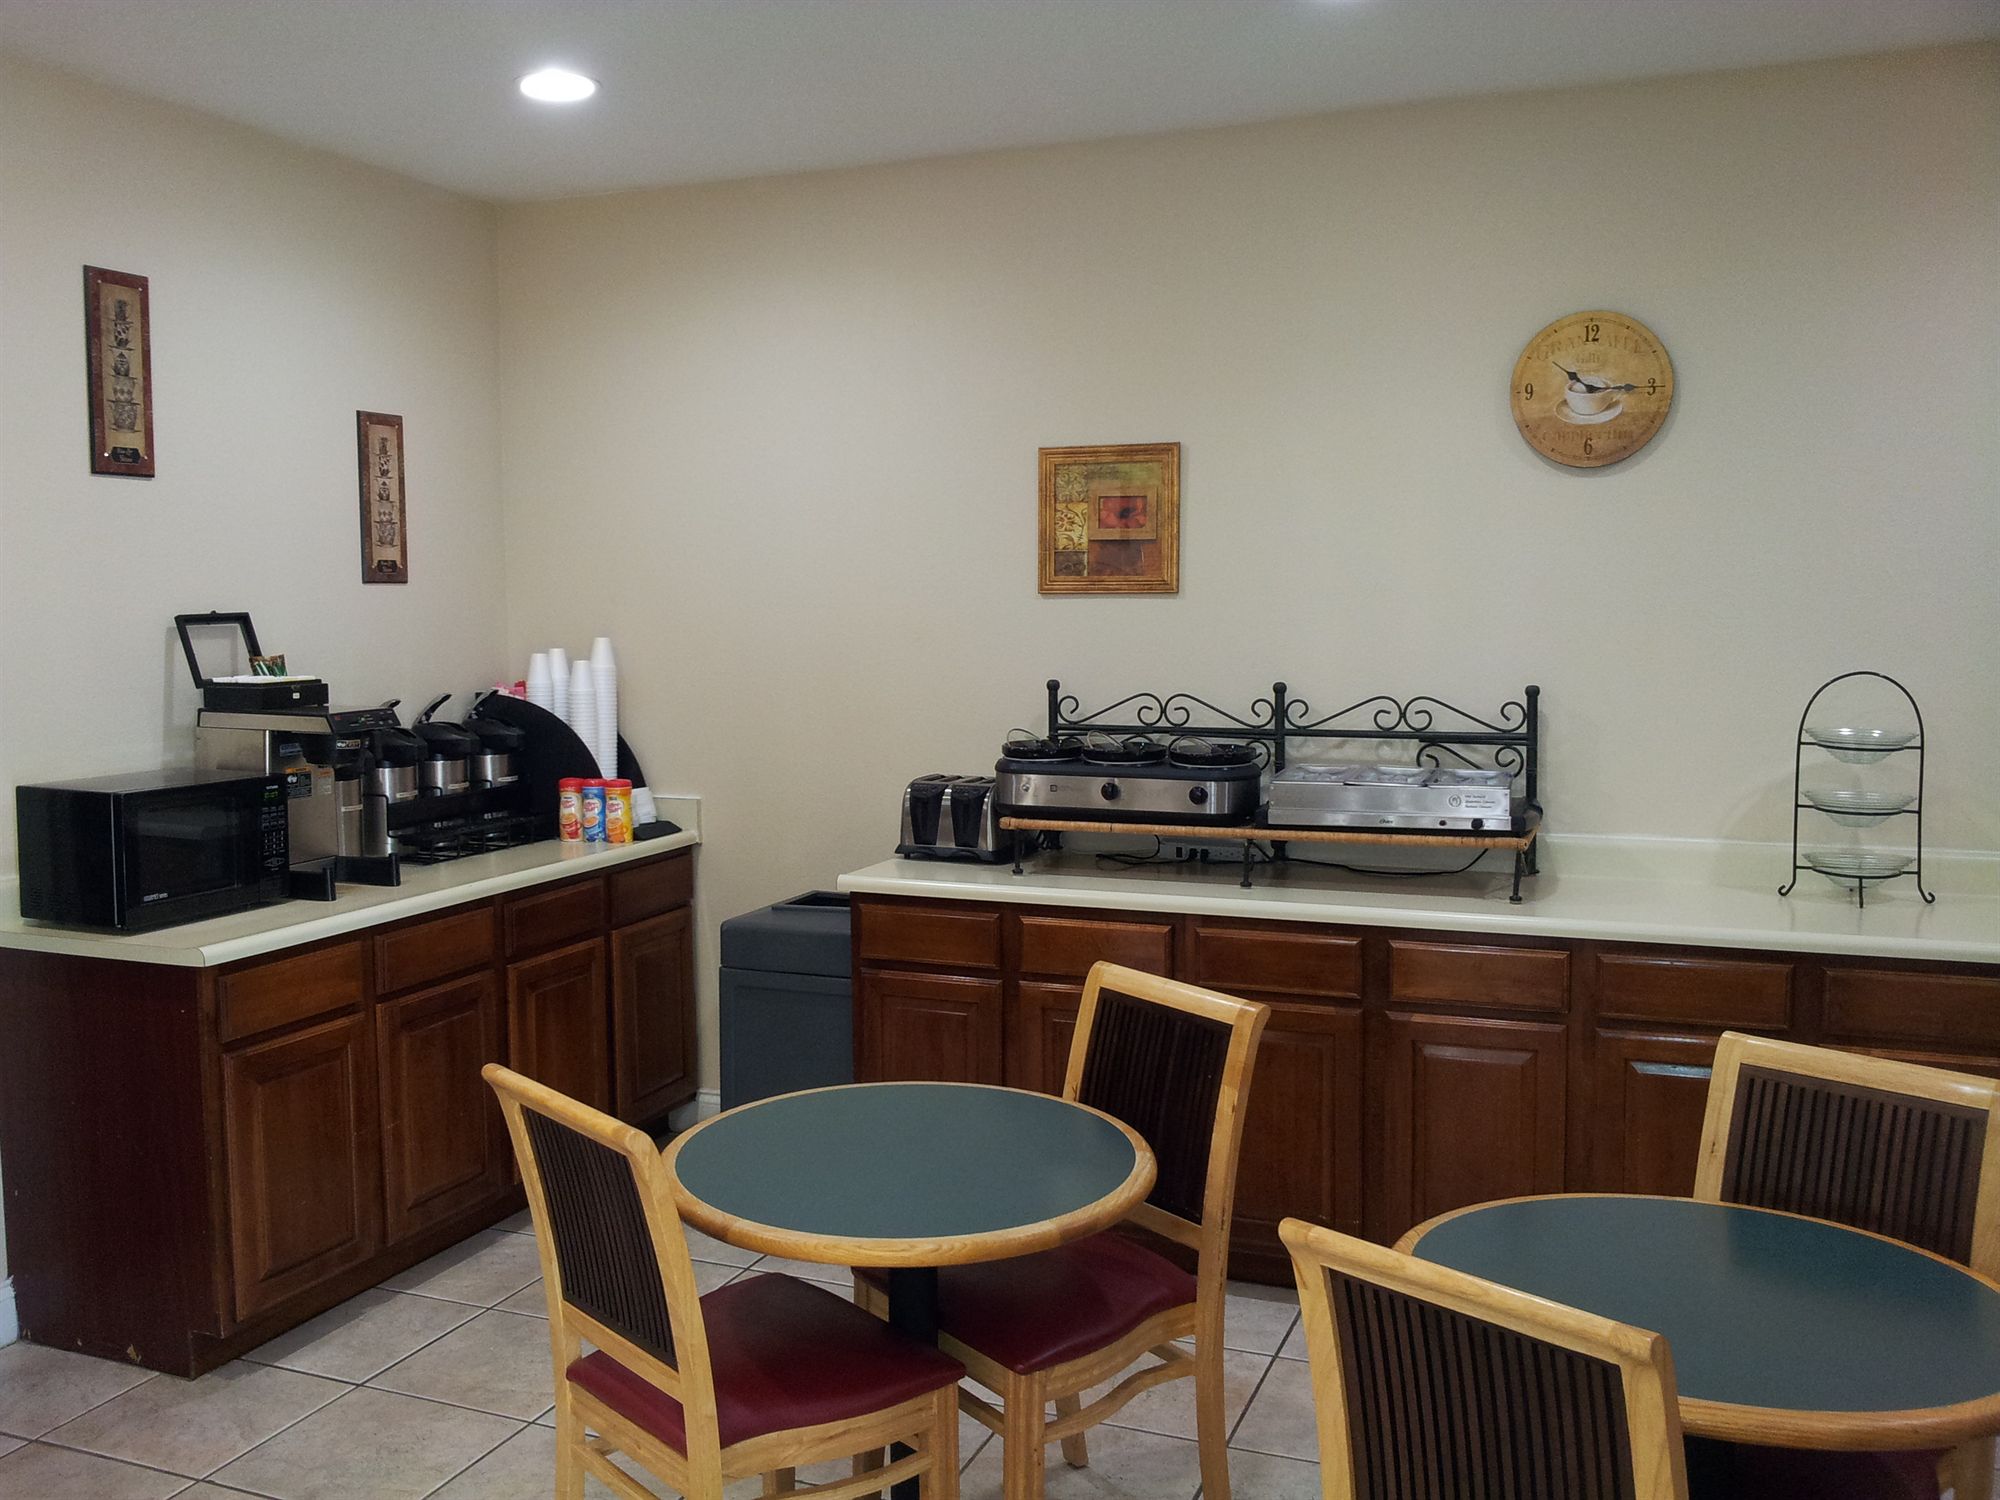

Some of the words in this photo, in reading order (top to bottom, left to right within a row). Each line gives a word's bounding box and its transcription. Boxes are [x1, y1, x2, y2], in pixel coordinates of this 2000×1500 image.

[1584, 324, 1600, 342] 12
[1525, 383, 1534, 400] 9
[1647, 378, 1656, 396] 3
[1584, 437, 1593, 455] 6
